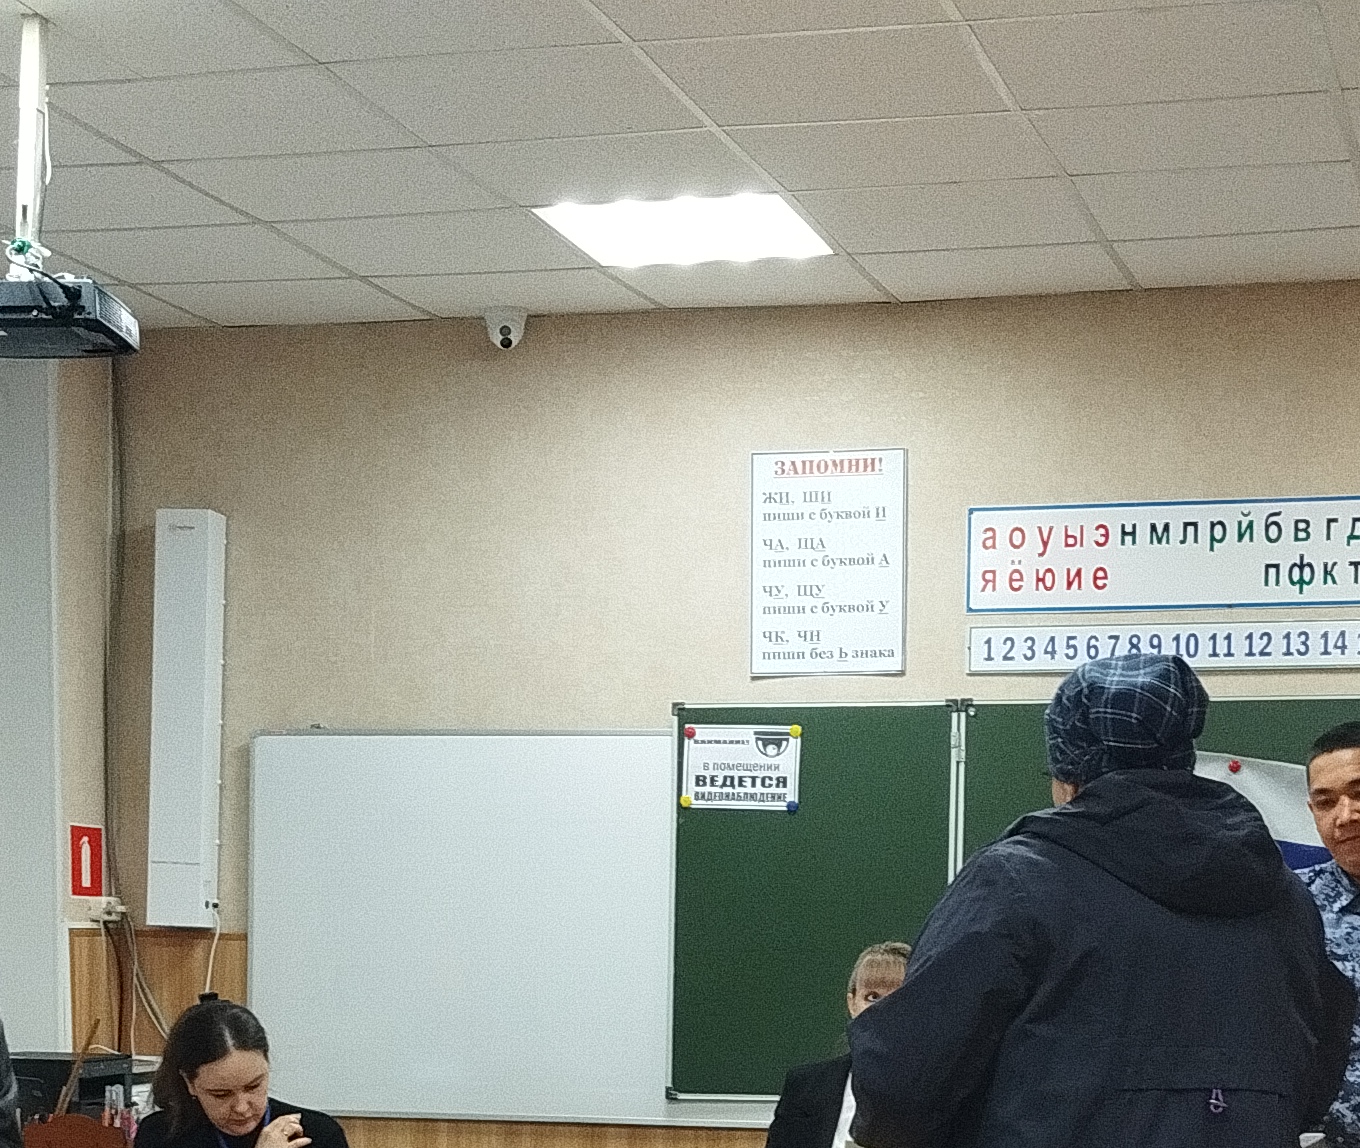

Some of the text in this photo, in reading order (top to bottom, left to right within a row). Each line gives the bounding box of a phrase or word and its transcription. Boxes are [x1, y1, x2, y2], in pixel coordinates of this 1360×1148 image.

[773, 456, 883, 475] ЗАПОМНИ!
[802, 490, 831, 503] ШИ
[761, 506, 886, 523] пиши с буквой И
[761, 537, 826, 551] ЧА, ЩА
[761, 552, 890, 569] пиши с буквой А
[761, 584, 825, 598] ЧУ, ЩУ
[761, 599, 889, 616] пиши с буквой У
[797, 629, 821, 642] ЧН
[983, 636, 994, 661] 1
[1001, 636, 1015, 661] 2
[1022, 635, 1036, 661] 3
[1043, 635, 1057, 660] 4
[1064, 635, 1078, 660] 5
[1086, 635, 1099, 660] 6
[1172, 632, 1199, 658] 10
[1207, 632, 1234, 657] 11
[1244, 631, 1272, 657] 12
[1281, 630, 1309, 656] 13
[1319, 629, 1347, 655] 14
[761, 650, 805, 660] пиши
[809, 647, 834, 659] без
[851, 647, 895, 659] знака
[695, 774, 787, 789] ВЕДЕТСЯ
[694, 791, 787, 803] ВИДЕОНАБЛЮДЕНИЕ
